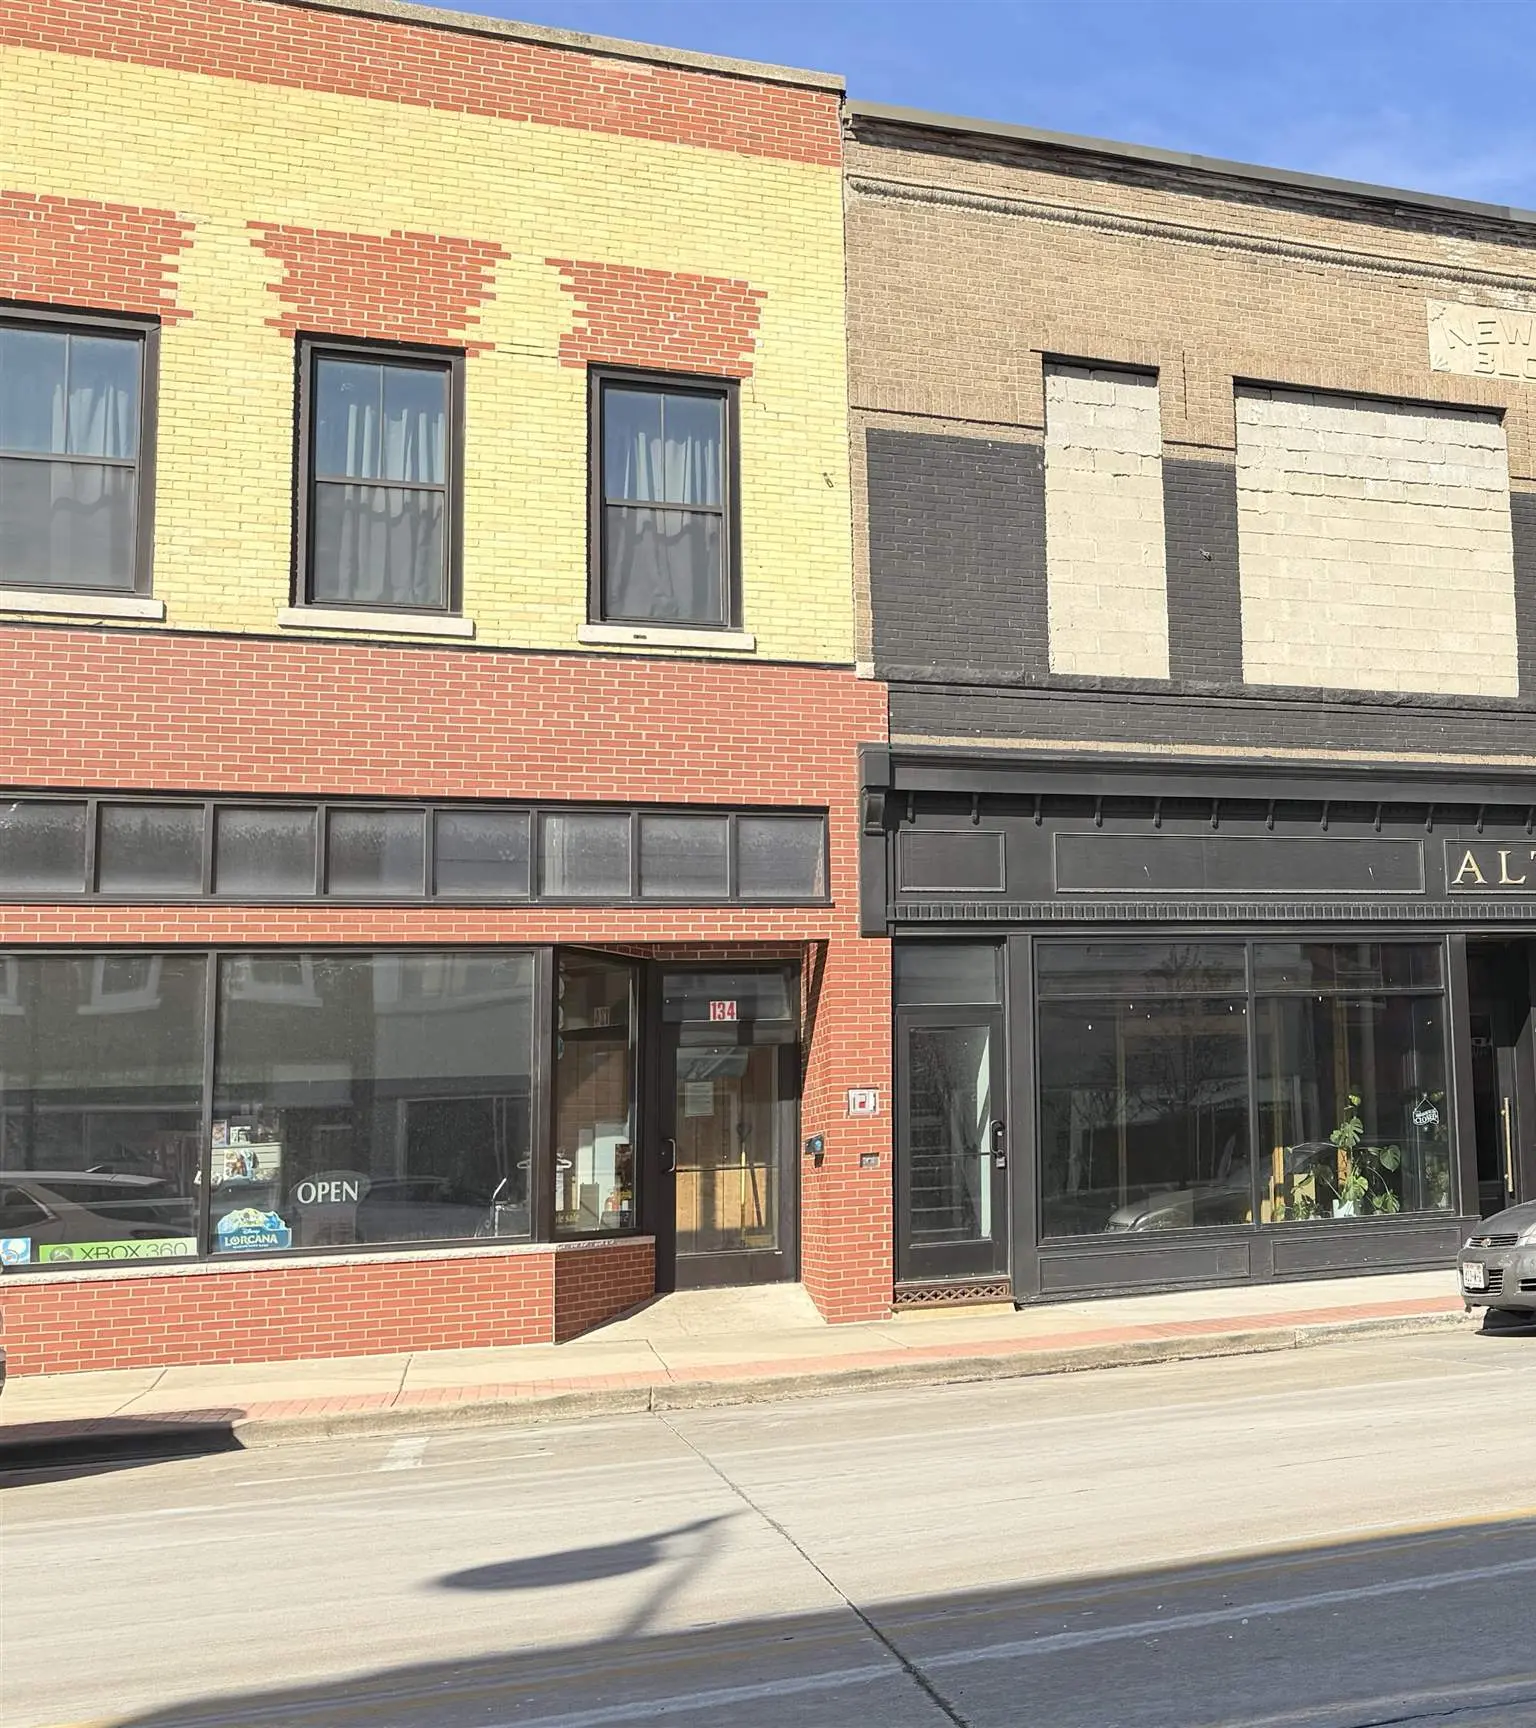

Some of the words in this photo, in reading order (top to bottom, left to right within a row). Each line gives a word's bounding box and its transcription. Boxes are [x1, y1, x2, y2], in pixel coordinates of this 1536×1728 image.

[711, 1002, 735, 1020] 134
[297, 1181, 359, 1204] OPEN
[224, 1233, 279, 1247] LORCANA
[80, 1245, 142, 1260] XBOX
[146, 1242, 188, 1257] 360
